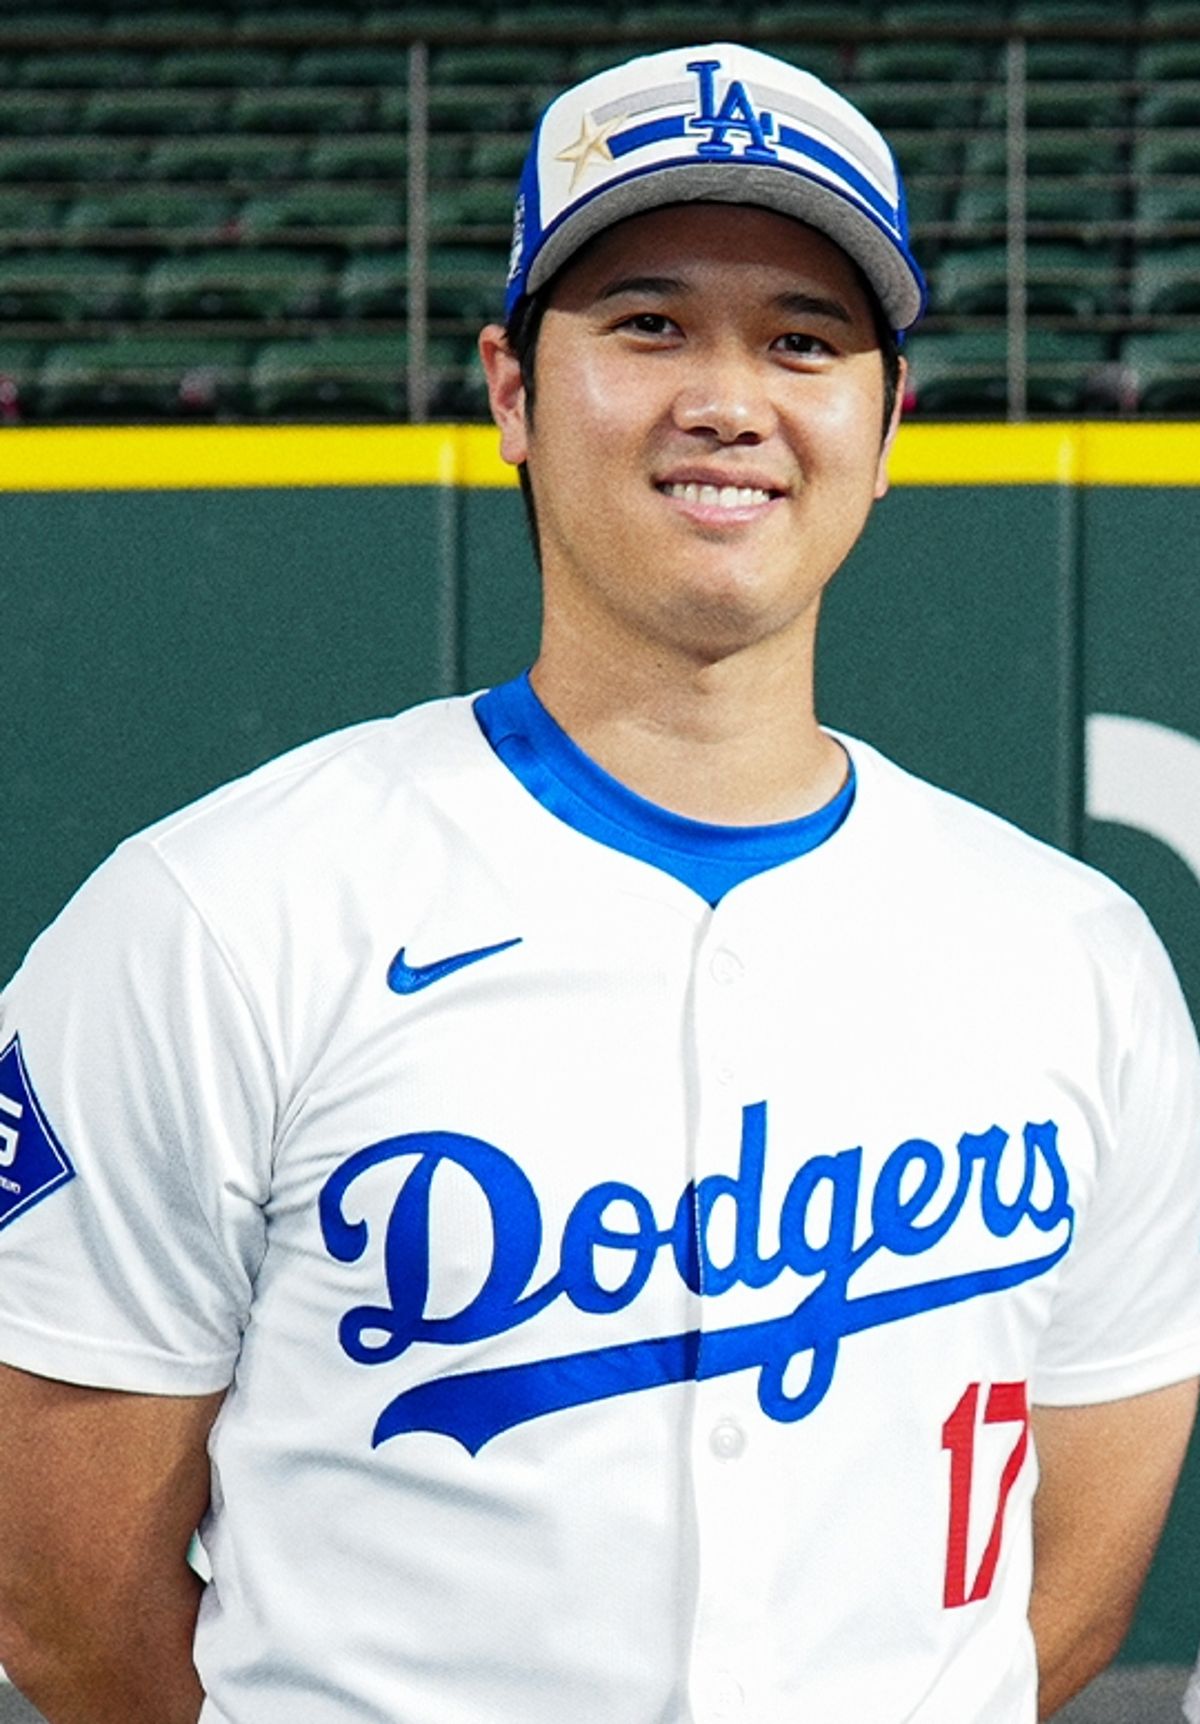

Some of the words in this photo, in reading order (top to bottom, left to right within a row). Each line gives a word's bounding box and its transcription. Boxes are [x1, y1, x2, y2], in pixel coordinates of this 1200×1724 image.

[686, 60, 778, 159] LA
[319, 1100, 1075, 1426] Dodgers
[941, 1381, 1029, 1609] 17
